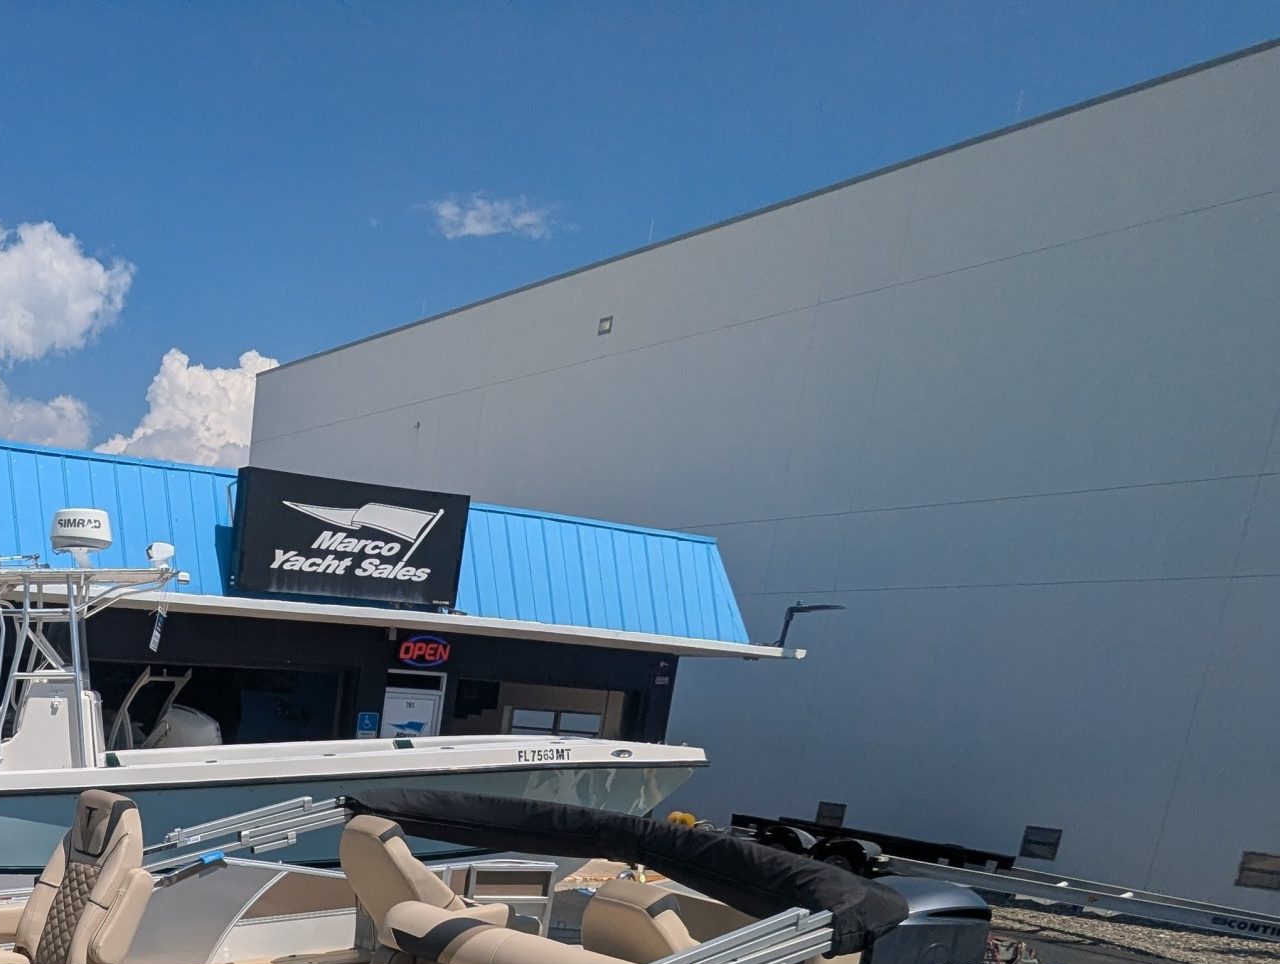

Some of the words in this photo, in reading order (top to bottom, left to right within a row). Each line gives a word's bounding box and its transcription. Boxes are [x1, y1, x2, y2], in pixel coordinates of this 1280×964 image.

[57, 518, 101, 529] SIMRAD
[310, 530, 402, 557] Marco
[270, 549, 352, 575] Yacht
[354, 557, 431, 582] Sales
[400, 641, 450, 661] OPEN
[1227, 919, 1280, 936] CONTI
